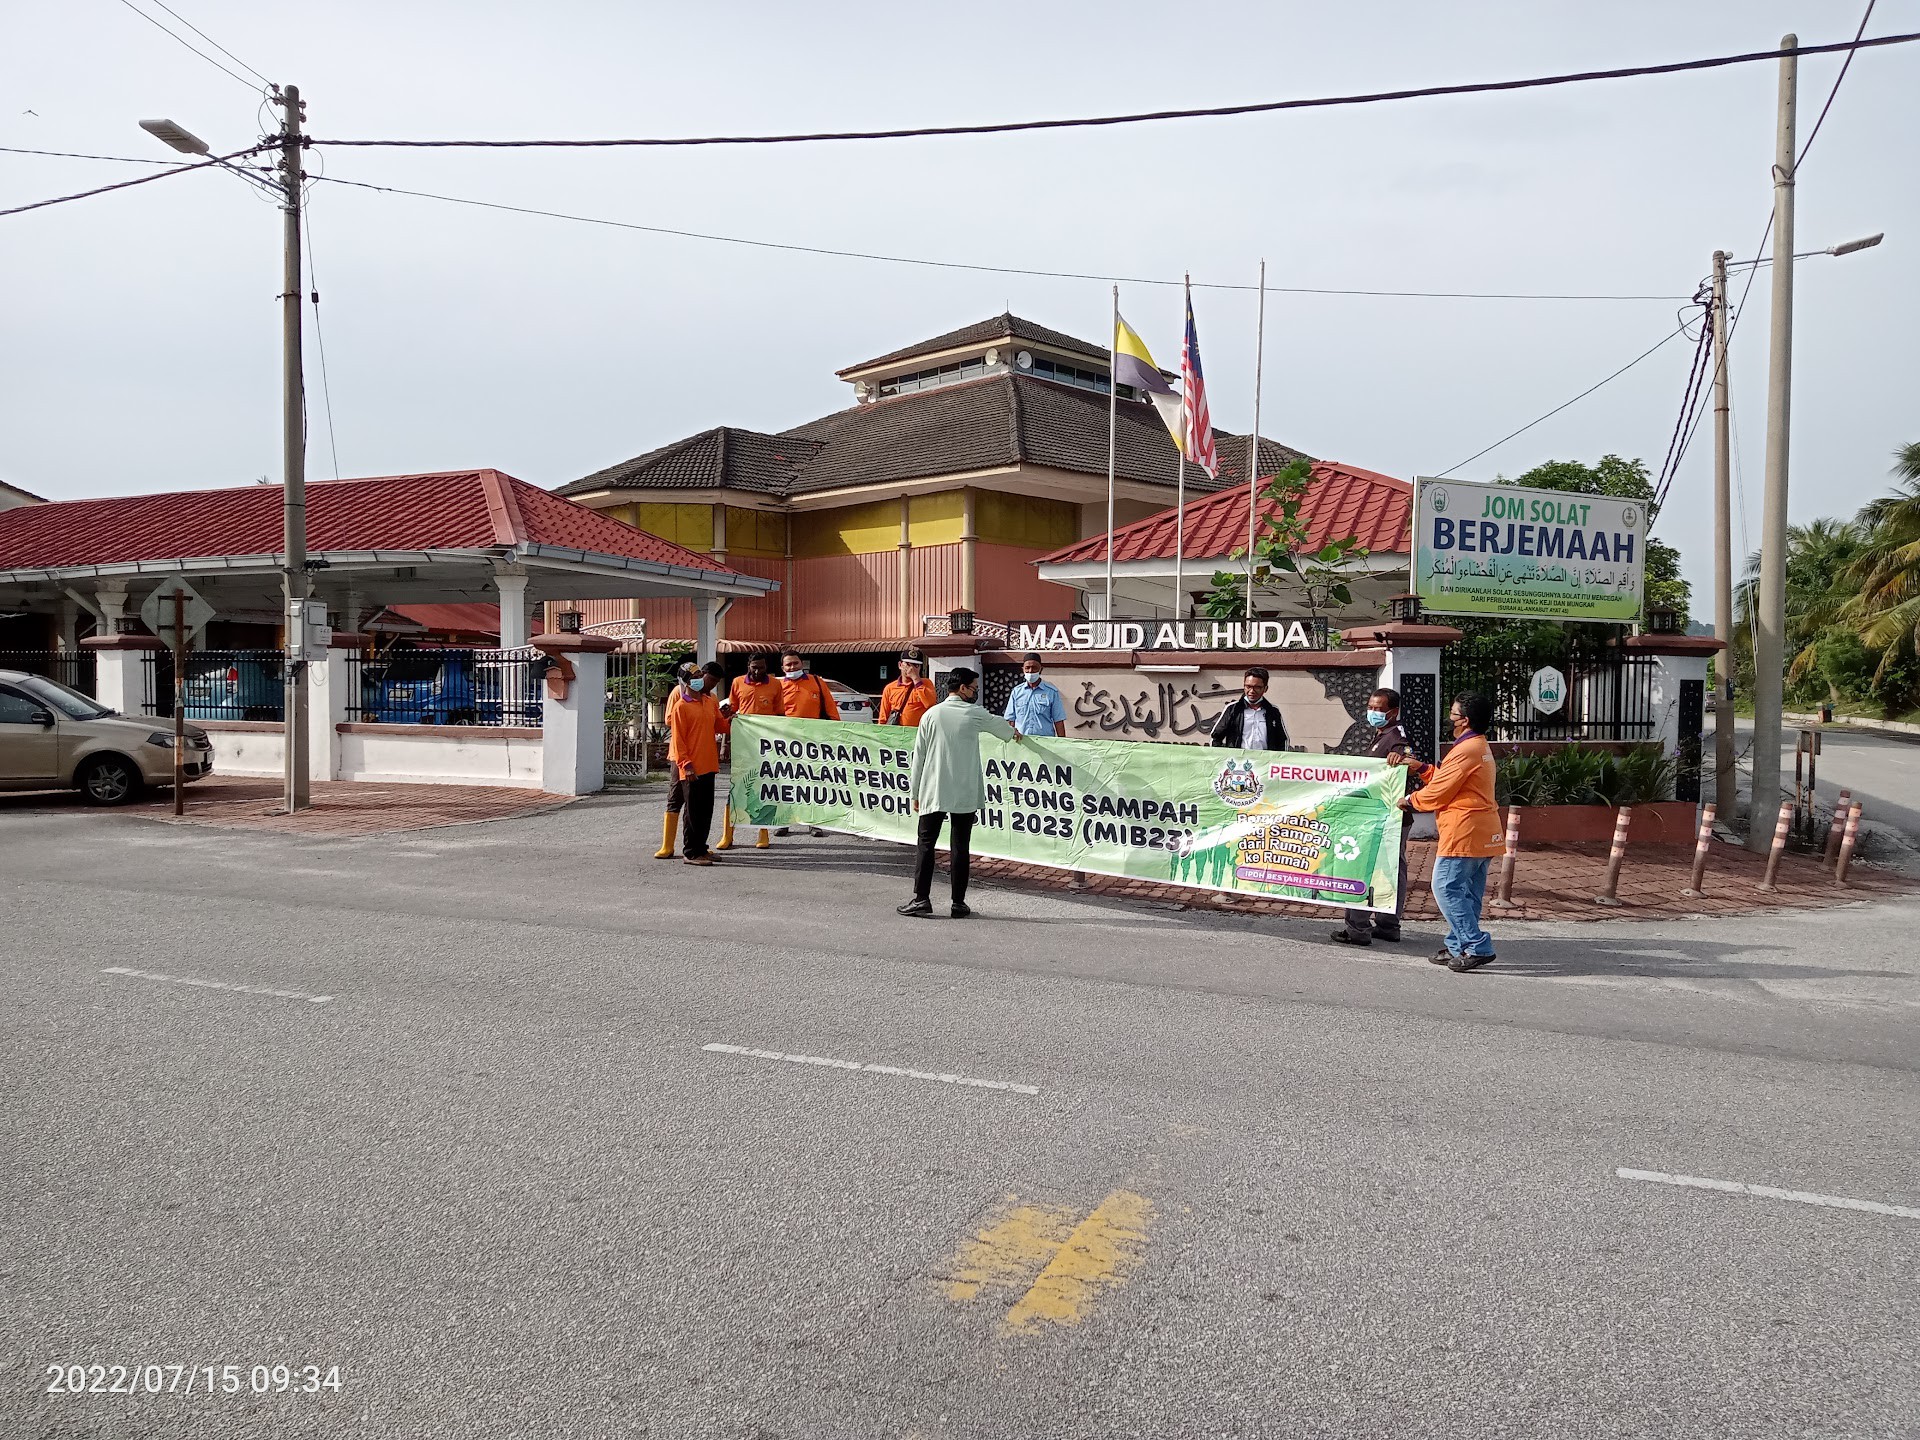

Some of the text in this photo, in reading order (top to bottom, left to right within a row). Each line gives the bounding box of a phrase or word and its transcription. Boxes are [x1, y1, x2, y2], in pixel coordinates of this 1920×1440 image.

[1481, 495, 1591, 527] JOM SOLAT
[1433, 517, 1635, 564] BERJEMAAH
[1440, 585, 1454, 593] DAN
[1455, 586, 1491, 595] DIRIKANLAH
[1513, 590, 1561, 599] SESUNGGUHNYA
[1562, 592, 1581, 600] SOLAT
[1471, 595, 1486, 603] DARI
[1486, 596, 1522, 605] PERBUATAN
[1019, 620, 1310, 650] MASJID AL-HUDA
[759, 738, 872, 765] PROGRAM
[1269, 764, 1369, 785] PERCUMA!!!
[759, 761, 848, 786] AMALAN
[1009, 786, 1076, 813] TONG
[1082, 794, 1199, 826] SAMPAH
[760, 783, 852, 805] MENUJU
[859, 791, 911, 816] IPOH
[1011, 812, 1074, 838] 2023
[1082, 821, 1194, 858] (MIB23)
[1238, 838, 1319, 859] dari Rumah
[1269, 824, 1332, 849] Sampah
[1244, 851, 1310, 870] ke Rumah
[1244, 869, 1356, 891] IPOH BESTARI SEJAHTERA
